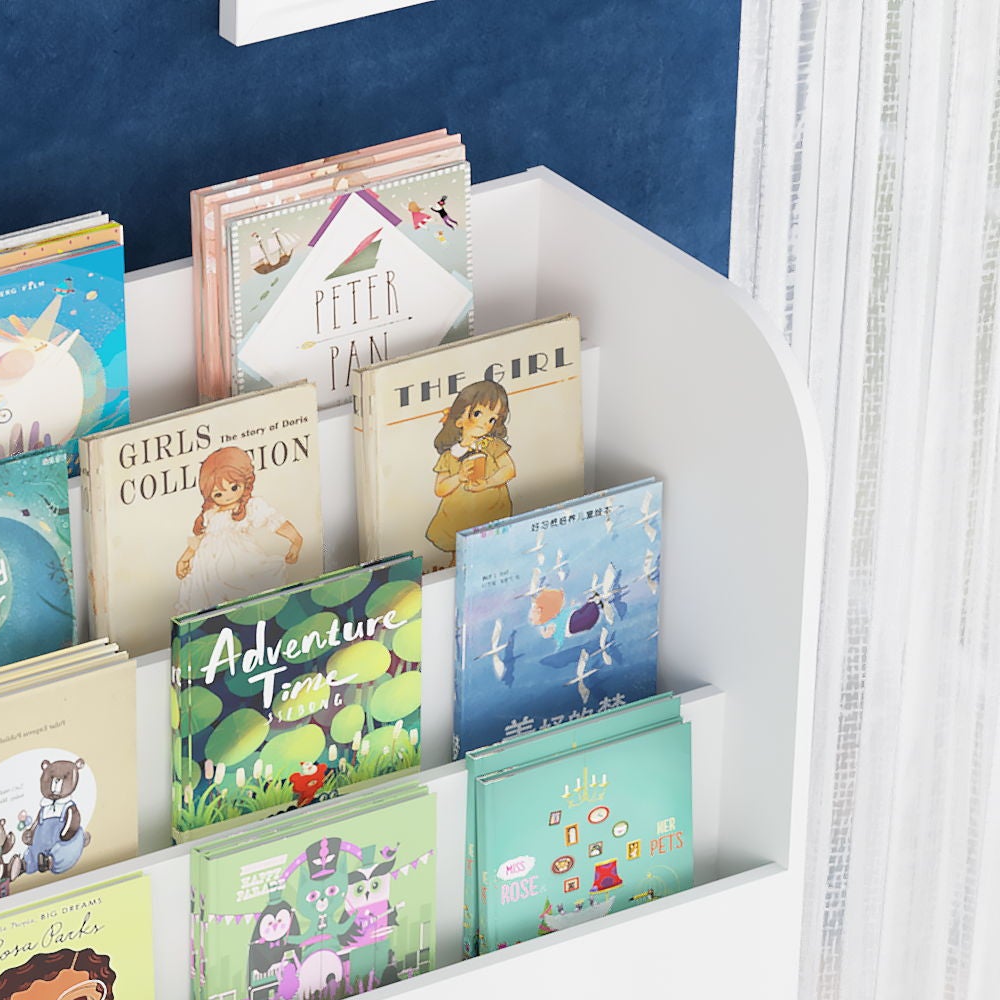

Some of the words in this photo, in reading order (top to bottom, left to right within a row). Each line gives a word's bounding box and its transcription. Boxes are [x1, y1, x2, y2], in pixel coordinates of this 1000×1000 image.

[315, 270, 400, 334] PETER
[330, 331, 388, 391] PAN
[394, 371, 466, 408] THE
[484, 347, 574, 384] GIRL
[119, 424, 212, 470] GIRLS
[220, 432, 239, 444] The
[241, 426, 266, 439] story
[269, 421, 279, 432] of
[282, 415, 309, 429] Doris
[120, 434, 312, 506] COLLION
[200, 609, 408, 685] Adventure
[248, 666, 359, 709] Time
[650, 831, 684, 857] PETS
[501, 875, 539, 905] ROSE
[41, 911, 105, 949] Parks
